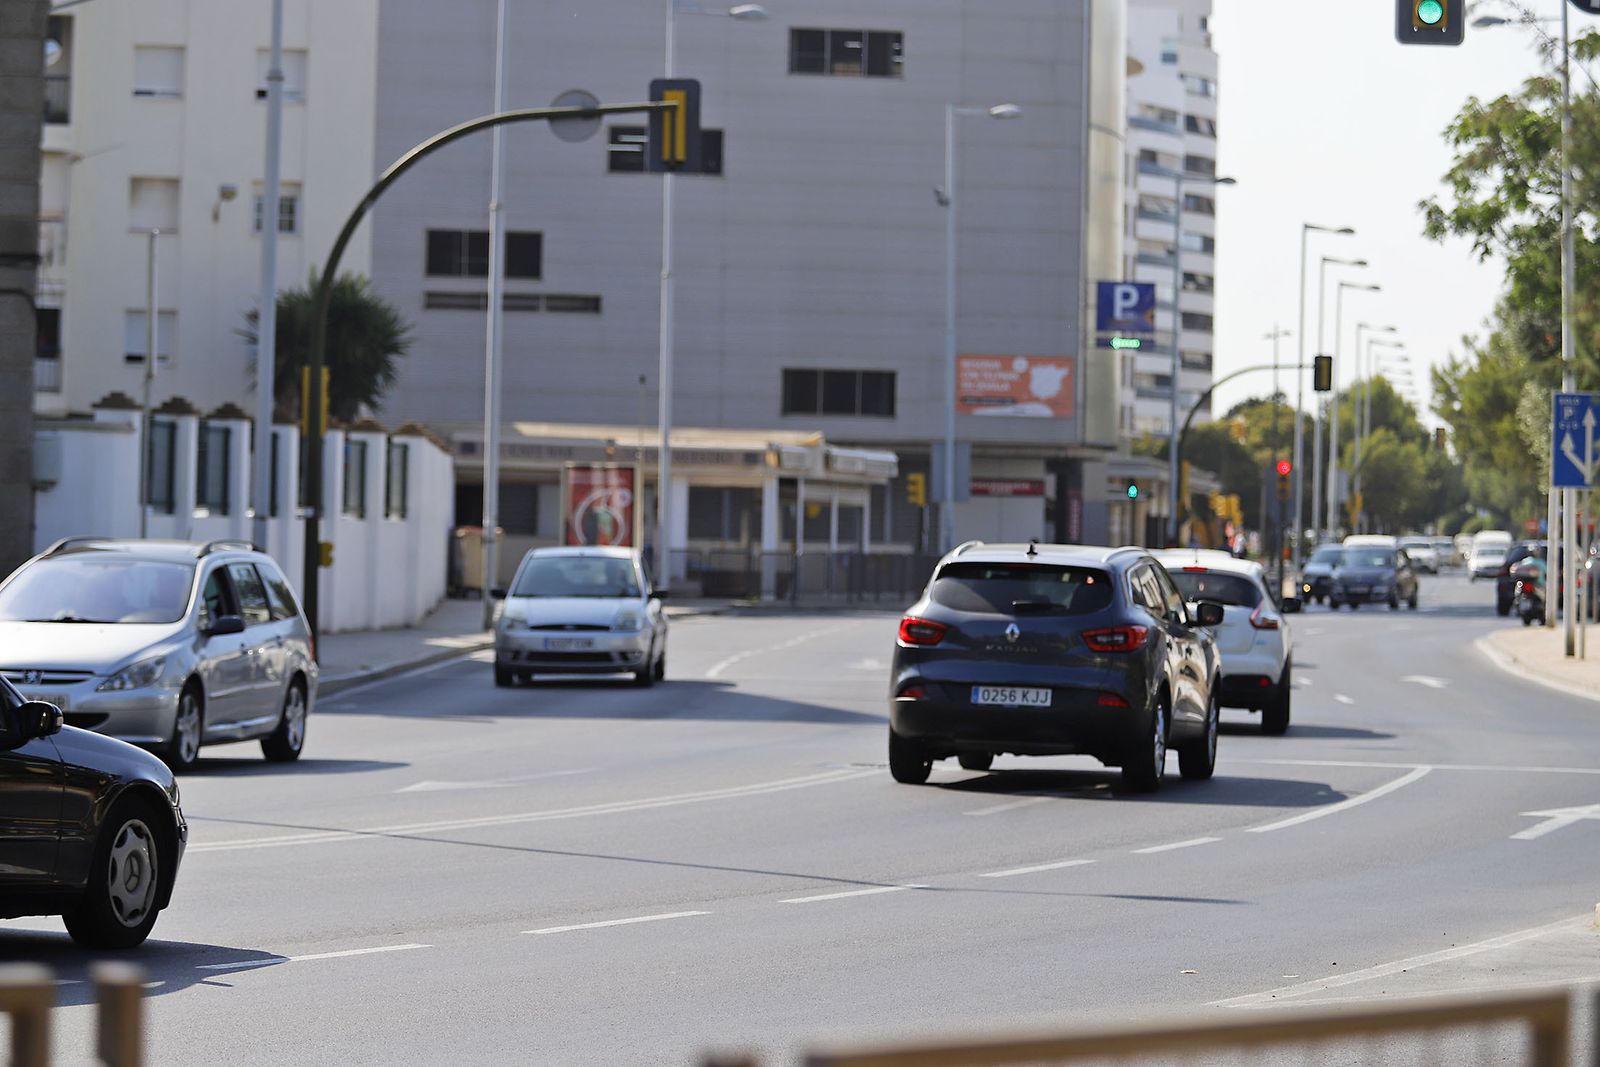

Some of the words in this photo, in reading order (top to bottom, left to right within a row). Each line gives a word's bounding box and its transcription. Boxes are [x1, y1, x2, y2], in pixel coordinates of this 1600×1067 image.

[1113, 285, 1139, 320] P
[981, 688, 1016, 702] 0256
[1021, 690, 1049, 704] KJJ
